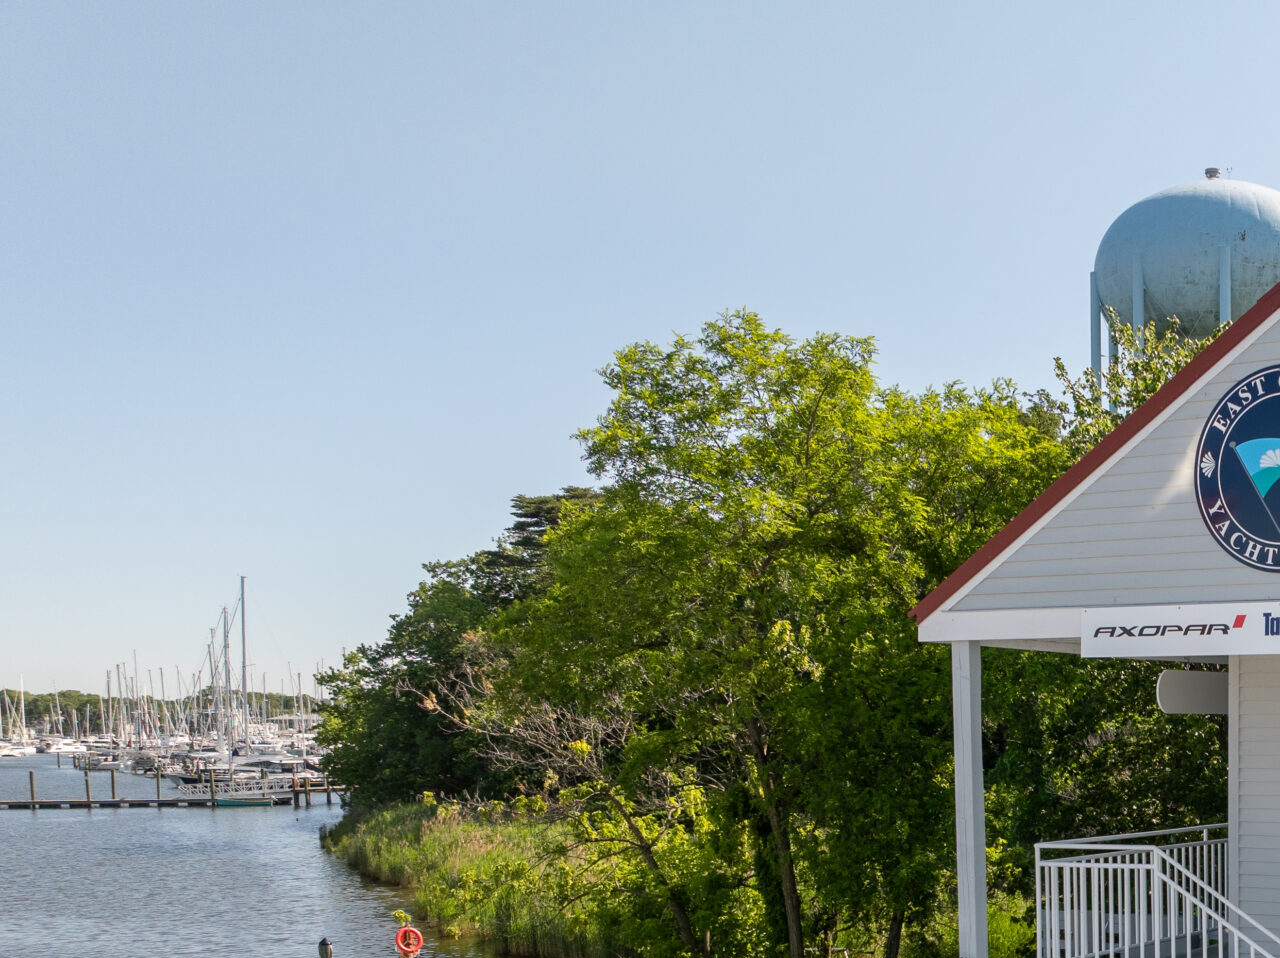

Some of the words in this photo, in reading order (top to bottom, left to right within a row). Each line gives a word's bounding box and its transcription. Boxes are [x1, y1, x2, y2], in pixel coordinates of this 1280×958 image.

[1212, 377, 1267, 434] EAST
[1208, 498, 1278, 564] YACHT
[1093, 623, 1231, 638] AXOPAR
